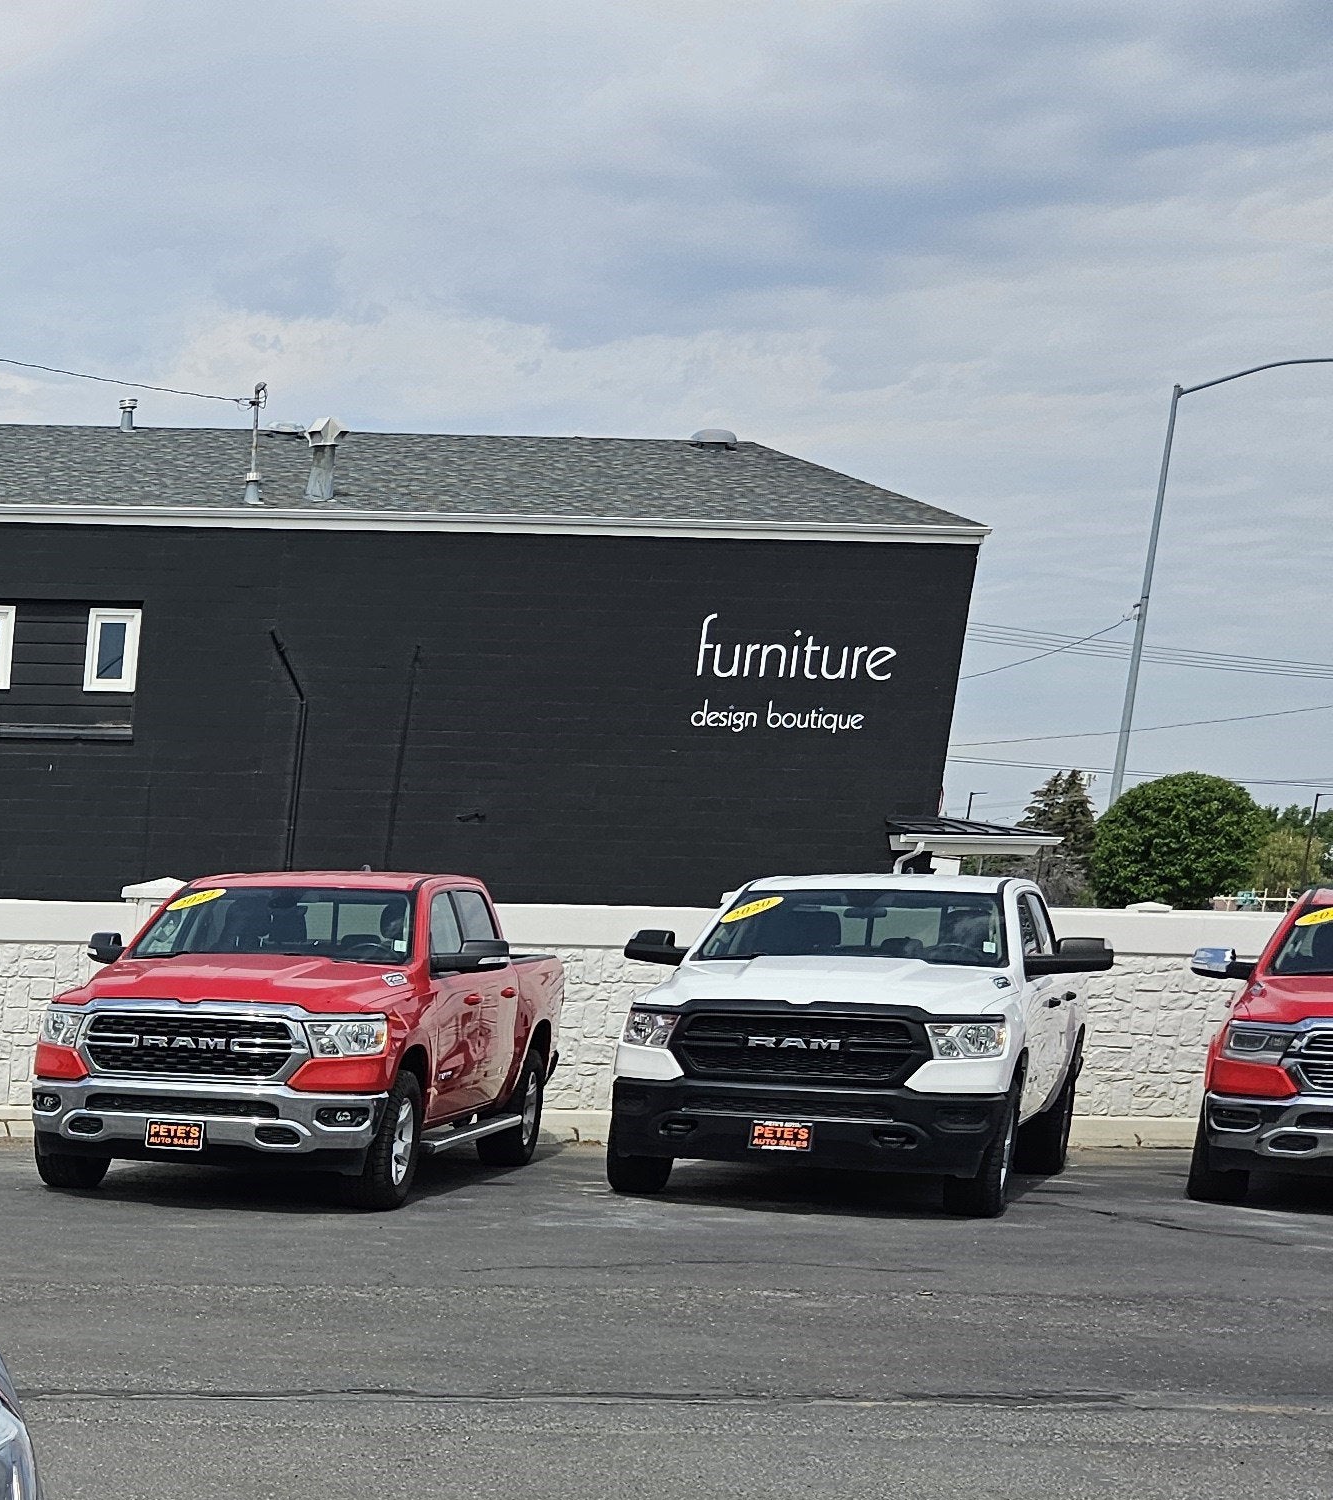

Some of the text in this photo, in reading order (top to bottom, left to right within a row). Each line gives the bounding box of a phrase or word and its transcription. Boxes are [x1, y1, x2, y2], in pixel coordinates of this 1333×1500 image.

[696, 613, 897, 681] furniture
[691, 699, 865, 734] design boutique
[732, 900, 771, 919] 2020
[143, 1035, 226, 1050] RAM
[747, 1036, 842, 1051] RAM
[150, 1124, 200, 1138] PETE'S
[753, 1126, 809, 1140] PETE'S
[148, 1136, 199, 1146] AUTO SALES
[778, 1139, 808, 1148] SALES
